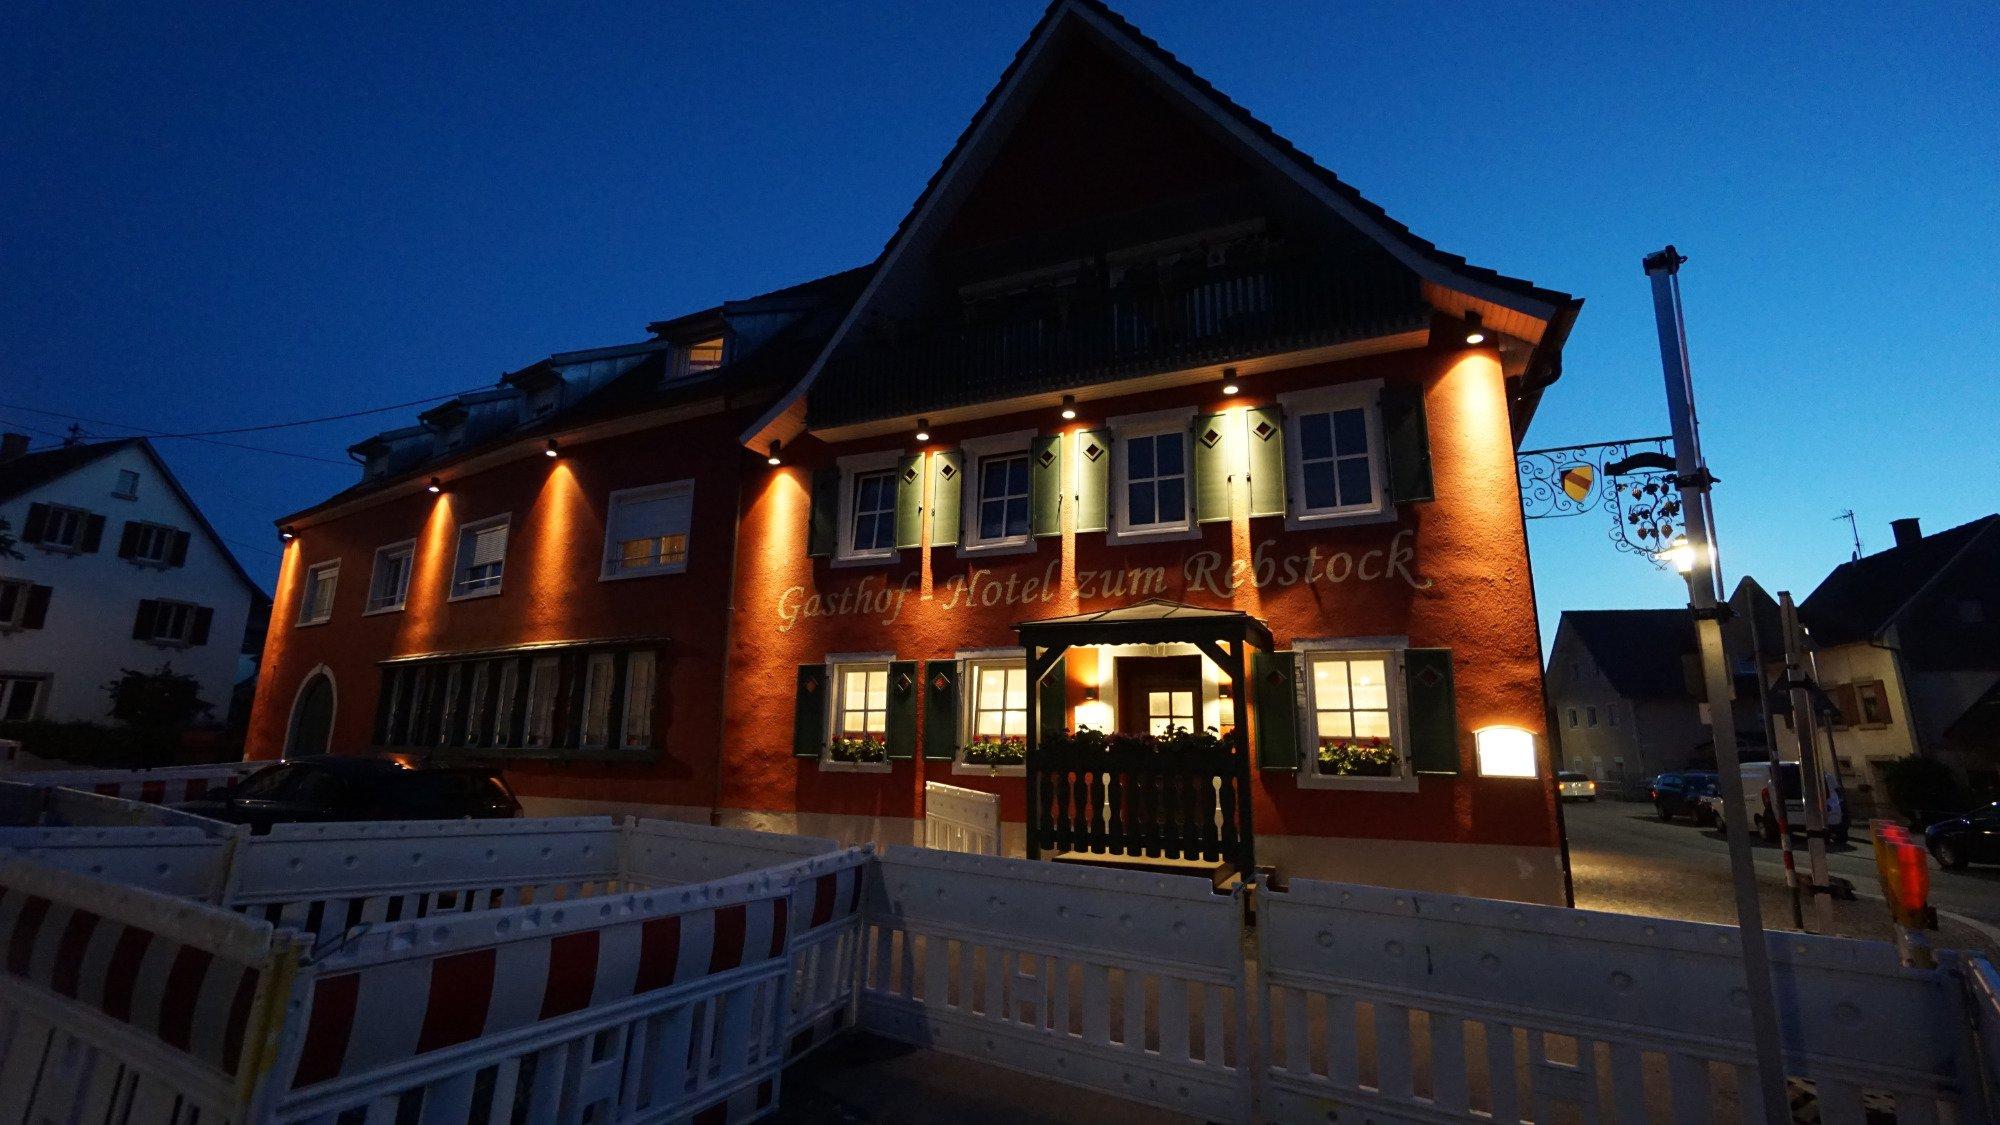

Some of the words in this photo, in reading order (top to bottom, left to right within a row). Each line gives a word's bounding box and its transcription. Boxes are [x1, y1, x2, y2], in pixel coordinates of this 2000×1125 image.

[777, 571, 919, 632] Gasthof
[942, 559, 1059, 610] Hotel
[1070, 567, 1167, 599] zum
[1183, 529, 1433, 599] Rebstock
